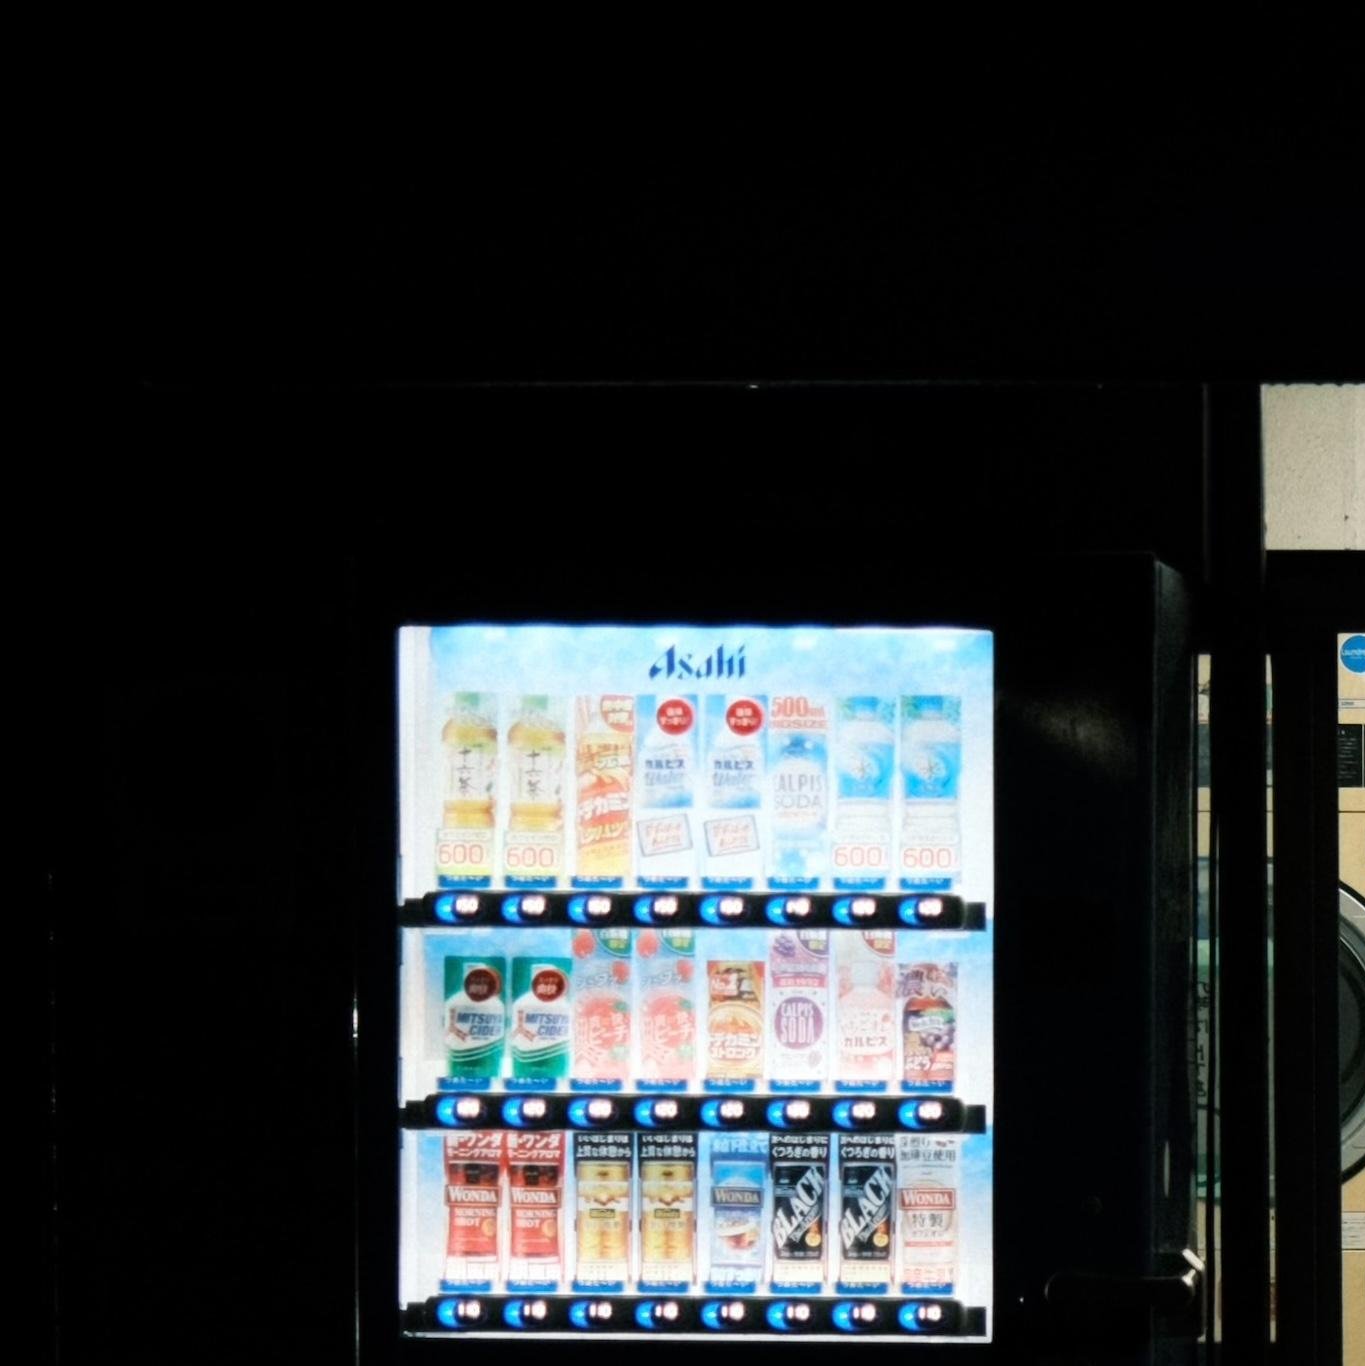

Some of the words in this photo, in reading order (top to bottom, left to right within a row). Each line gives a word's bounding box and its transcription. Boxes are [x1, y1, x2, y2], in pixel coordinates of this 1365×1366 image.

[648, 643, 748, 680] Asahi
[455, 747, 475, 797] 十六茶
[644, 759, 686, 770] カルピス
[713, 759, 755, 770] カルピス
[524, 750, 543, 799] 十六茶
[438, 843, 485, 866] 600
[506, 846, 555, 869] 600
[834, 846, 883, 867] 600
[902, 847, 952, 869] 600
[780, 1003, 815, 1017] CALPIS
[779, 1016, 816, 1043] SODA
[843, 1036, 888, 1048] カルピス
[772, 1147, 828, 1159] くつろぎの香り
[841, 1147, 896, 1159] くつろぎの香り
[449, 1186, 497, 1203] WONDA
[511, 1187, 557, 1204] WONDA
[714, 1189, 760, 1205] WONDA
[902, 1190, 952, 1206] WONDA
[454, 1208, 496, 1218] MORNING
[515, 1208, 556, 1218] MORNING
[772, 1165, 826, 1249] BLACK
[840, 1164, 895, 1250] BLACK
[455, 1218, 481, 1227] SHOT
[516, 1219, 541, 1228] SHOT
[911, 1213, 945, 1230] 特製
